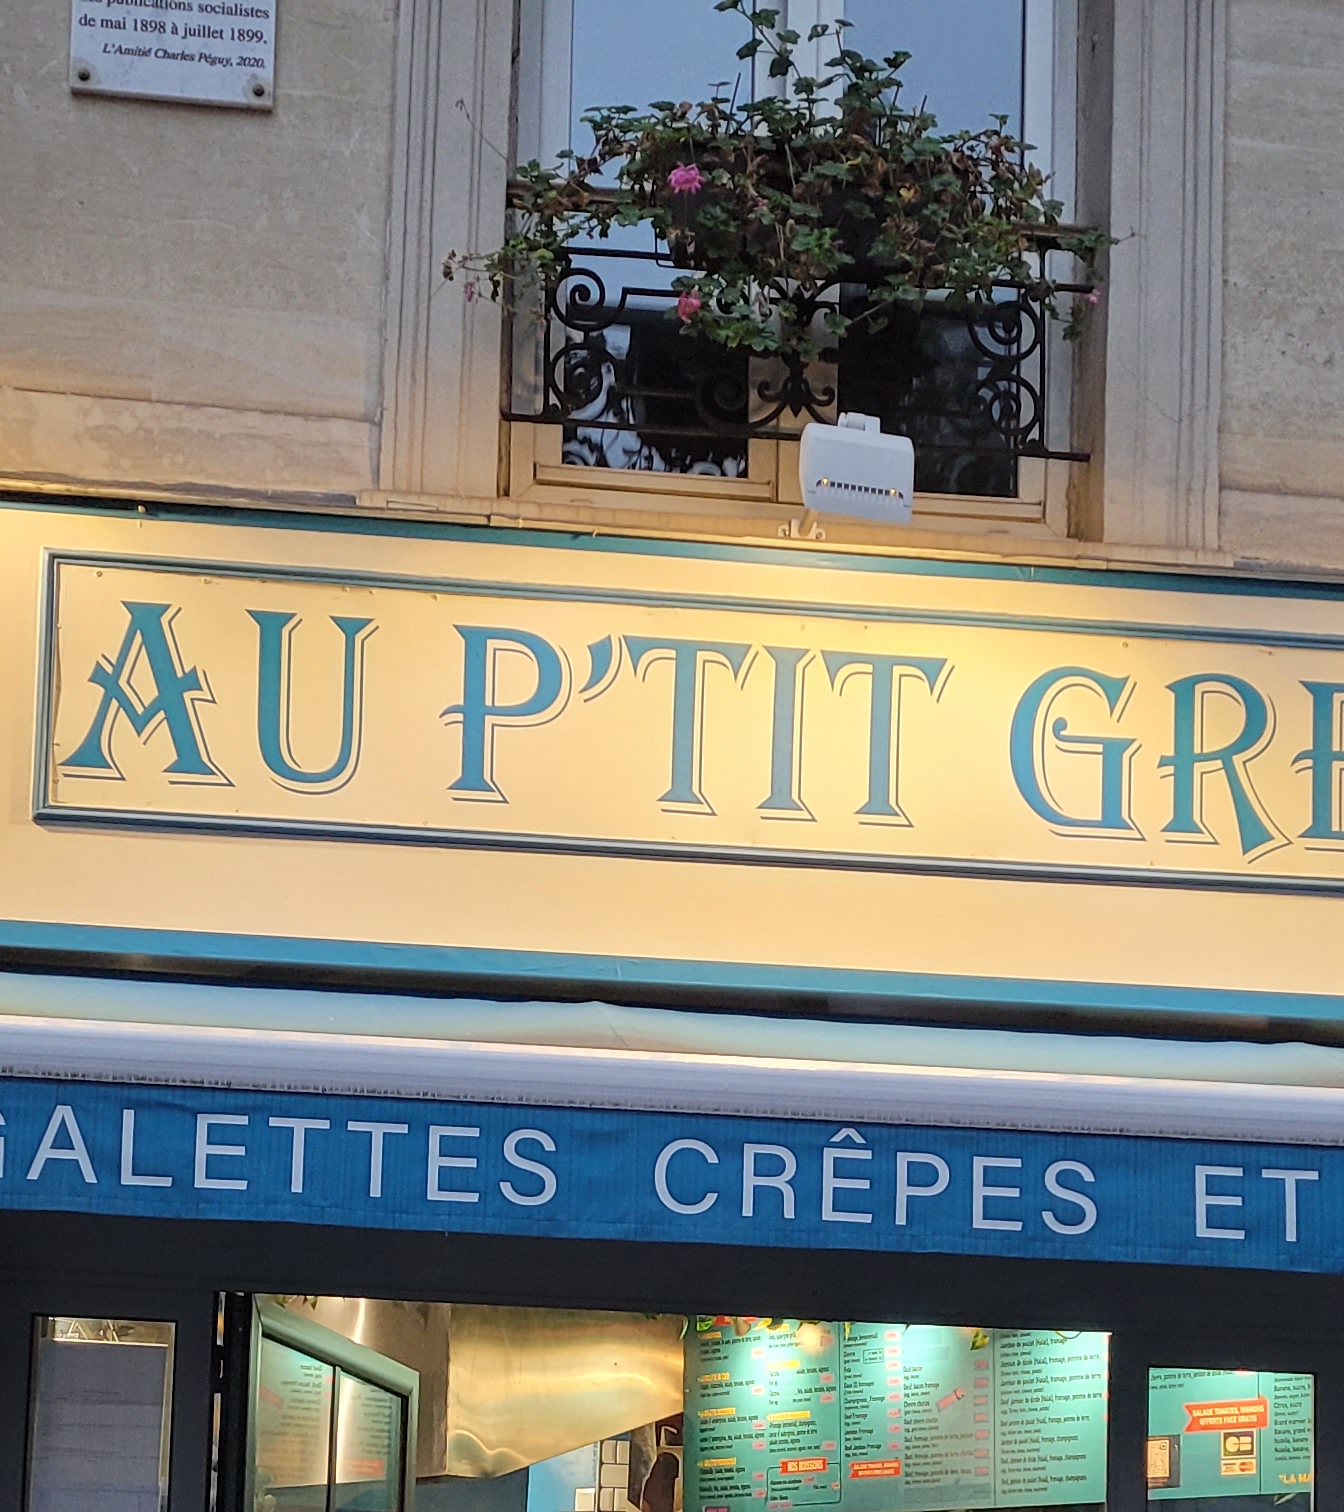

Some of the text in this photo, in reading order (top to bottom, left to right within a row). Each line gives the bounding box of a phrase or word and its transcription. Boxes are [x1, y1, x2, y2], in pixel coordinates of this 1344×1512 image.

[198, 2, 270, 19] socialistes
[79, 14, 267, 44] de mai 1898 à juillet 1899.
[155, 48, 195, 61] Charles
[58, 600, 380, 796] AU
[439, 622, 956, 828] P'TIT
[654, 1126, 1099, 1236] CRÊPES
[1192, 1163, 1320, 1243] ET
